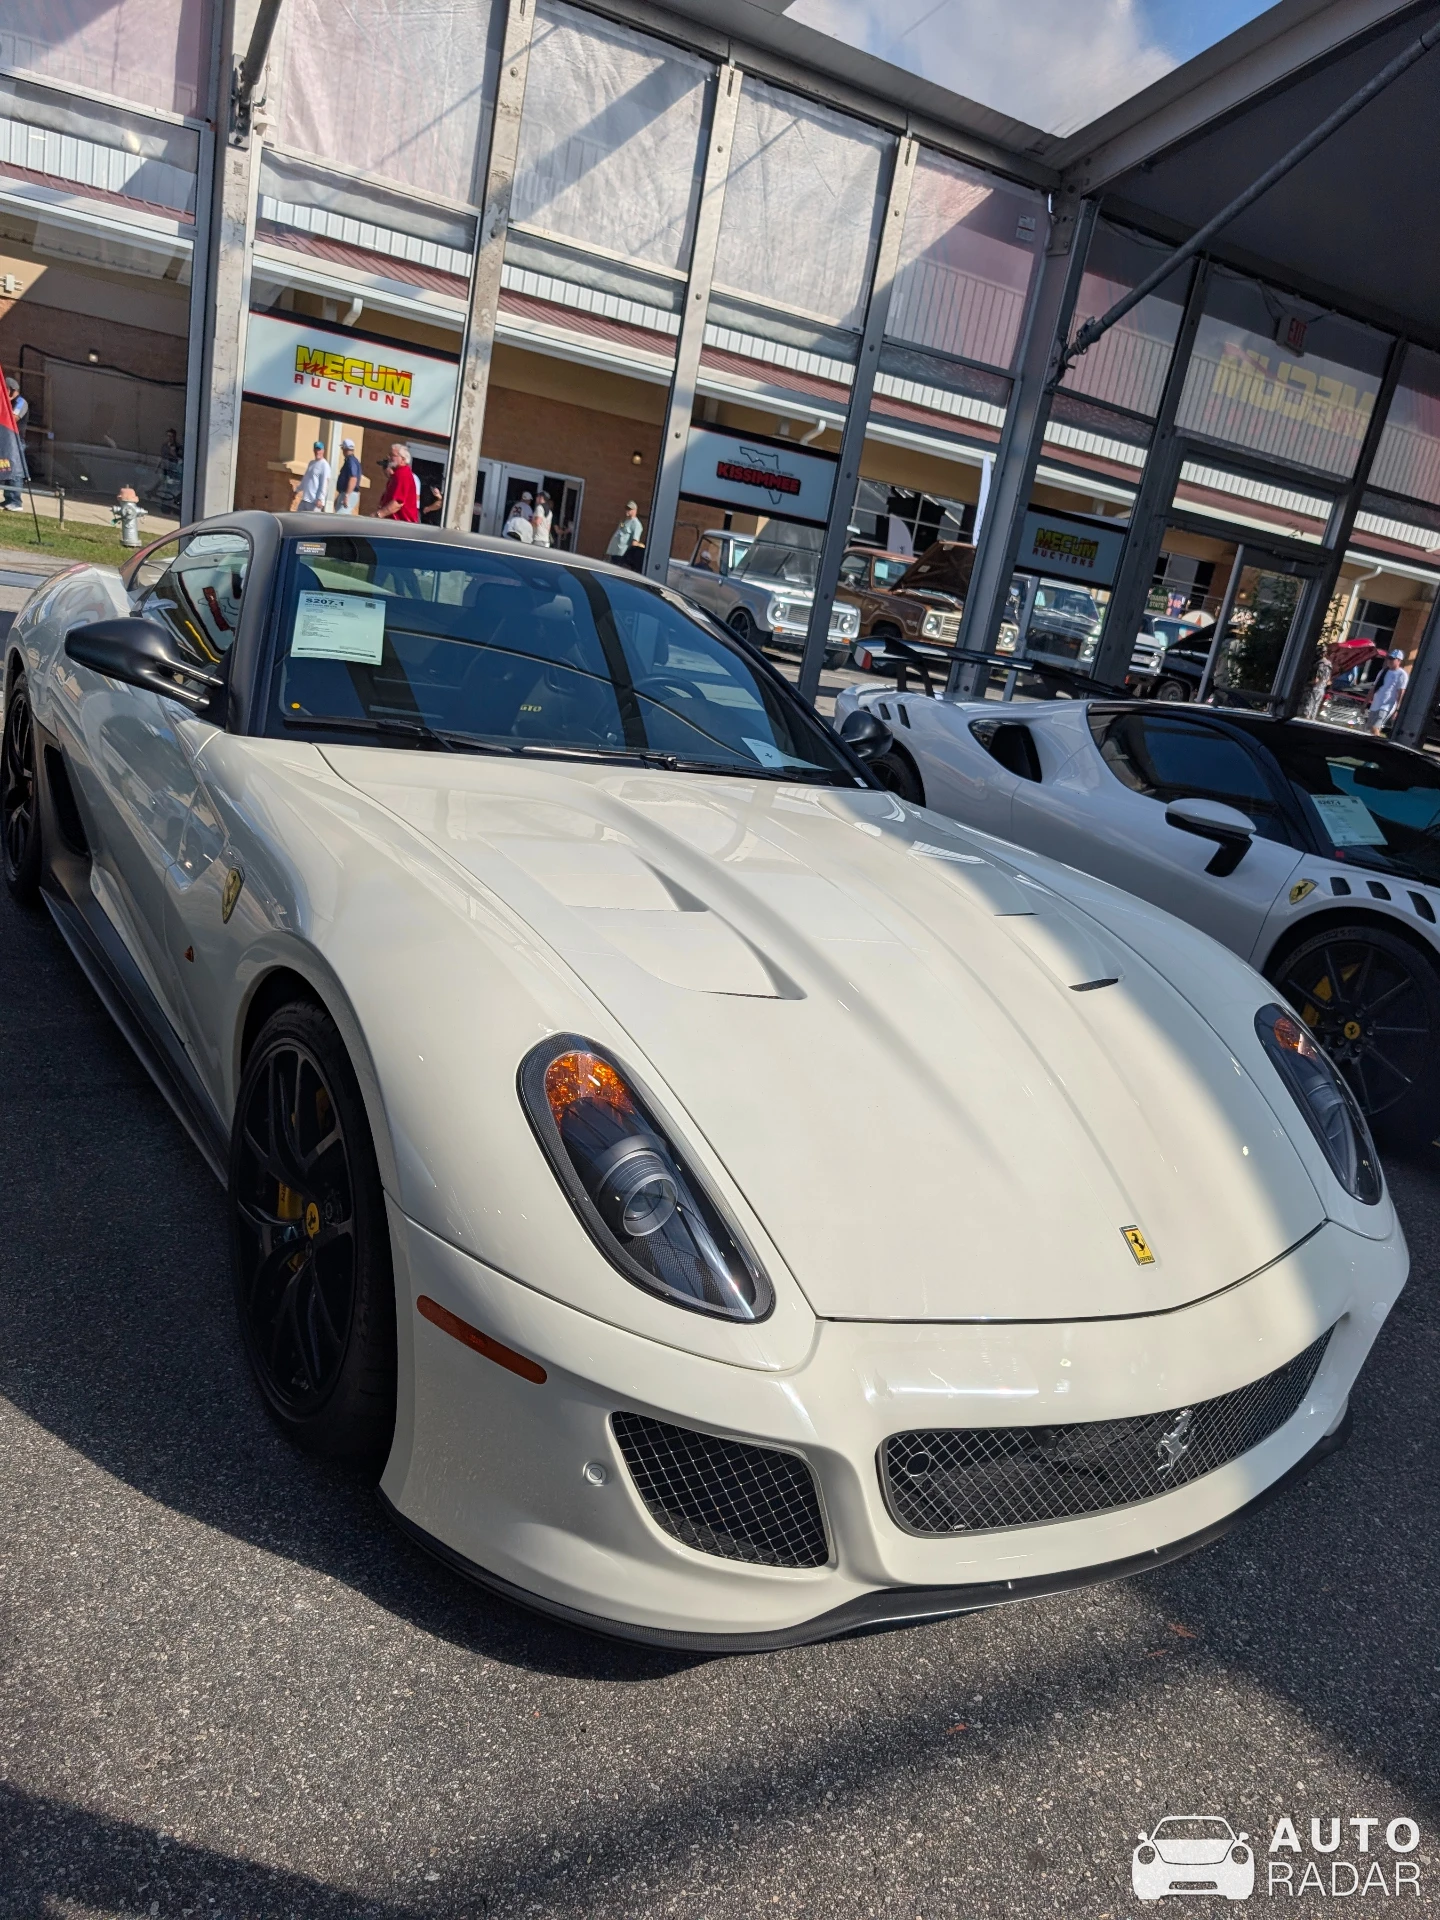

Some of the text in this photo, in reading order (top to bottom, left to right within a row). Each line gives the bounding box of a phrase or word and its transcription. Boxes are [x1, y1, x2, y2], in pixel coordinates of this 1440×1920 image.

[295, 345, 413, 397] MECUM
[294, 374, 410, 408] AUCTIONS
[717, 461, 801, 496] KISSIMMEE
[1032, 547, 1094, 568] AUCTIONS
[1034, 528, 1099, 560] MECUM
